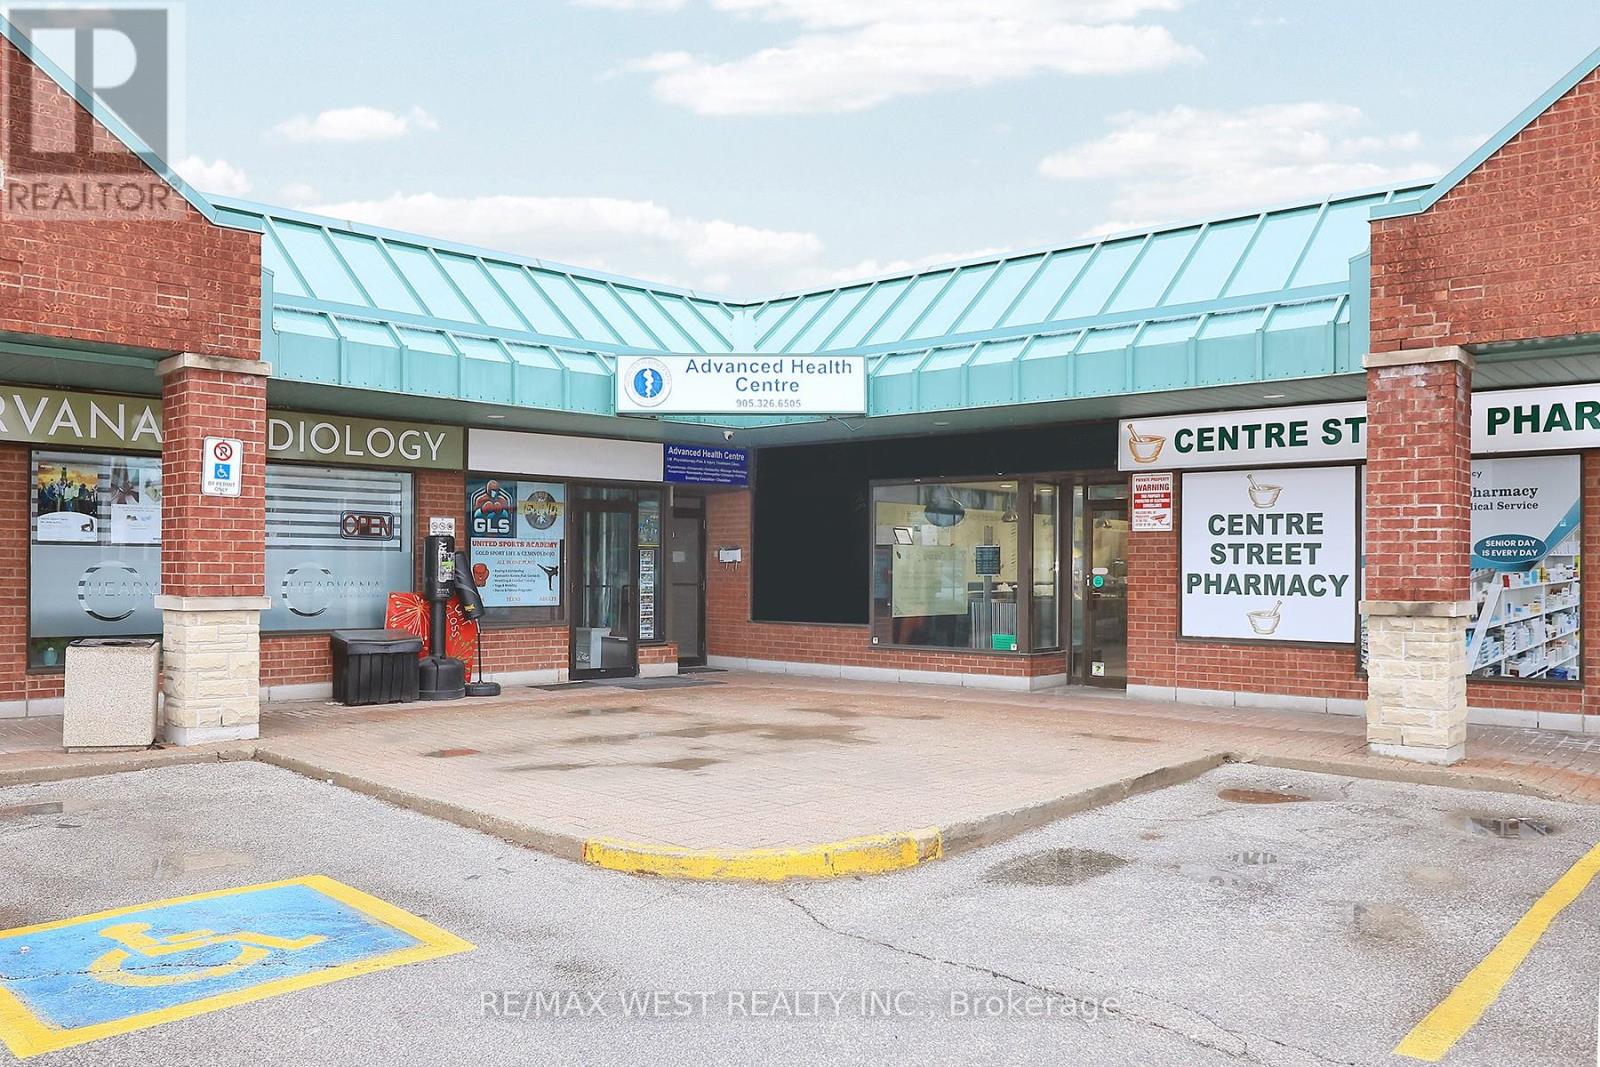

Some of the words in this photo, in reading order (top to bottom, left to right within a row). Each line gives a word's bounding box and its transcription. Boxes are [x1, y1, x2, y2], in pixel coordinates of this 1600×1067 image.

[685, 358, 784, 374] Advanced
[791, 358, 853, 375] Health
[735, 376, 801, 393] Centre
[735, 398, 802, 409] 905.326.6505
[1173, 420, 1309, 454] CENTRE
[1486, 400, 1600, 436] PHAR
[668, 446, 701, 457] Advanced
[702, 449, 722, 459] Health
[724, 451, 744, 461] Centre
[1136, 483, 1169, 491] WARNING
[1470, 486, 1539, 499] harmacy
[1496, 501, 1539, 510] Service
[343, 514, 392, 536] OPEN
[474, 519, 510, 533] GLS
[1207, 512, 1324, 536] CENTRE
[1209, 542, 1323, 565] STREET
[1481, 549, 1490, 557] IS
[1491, 549, 1518, 557] EVERY
[1519, 549, 1539, 557] DAY
[1186, 573, 1349, 598] PHARMACY
